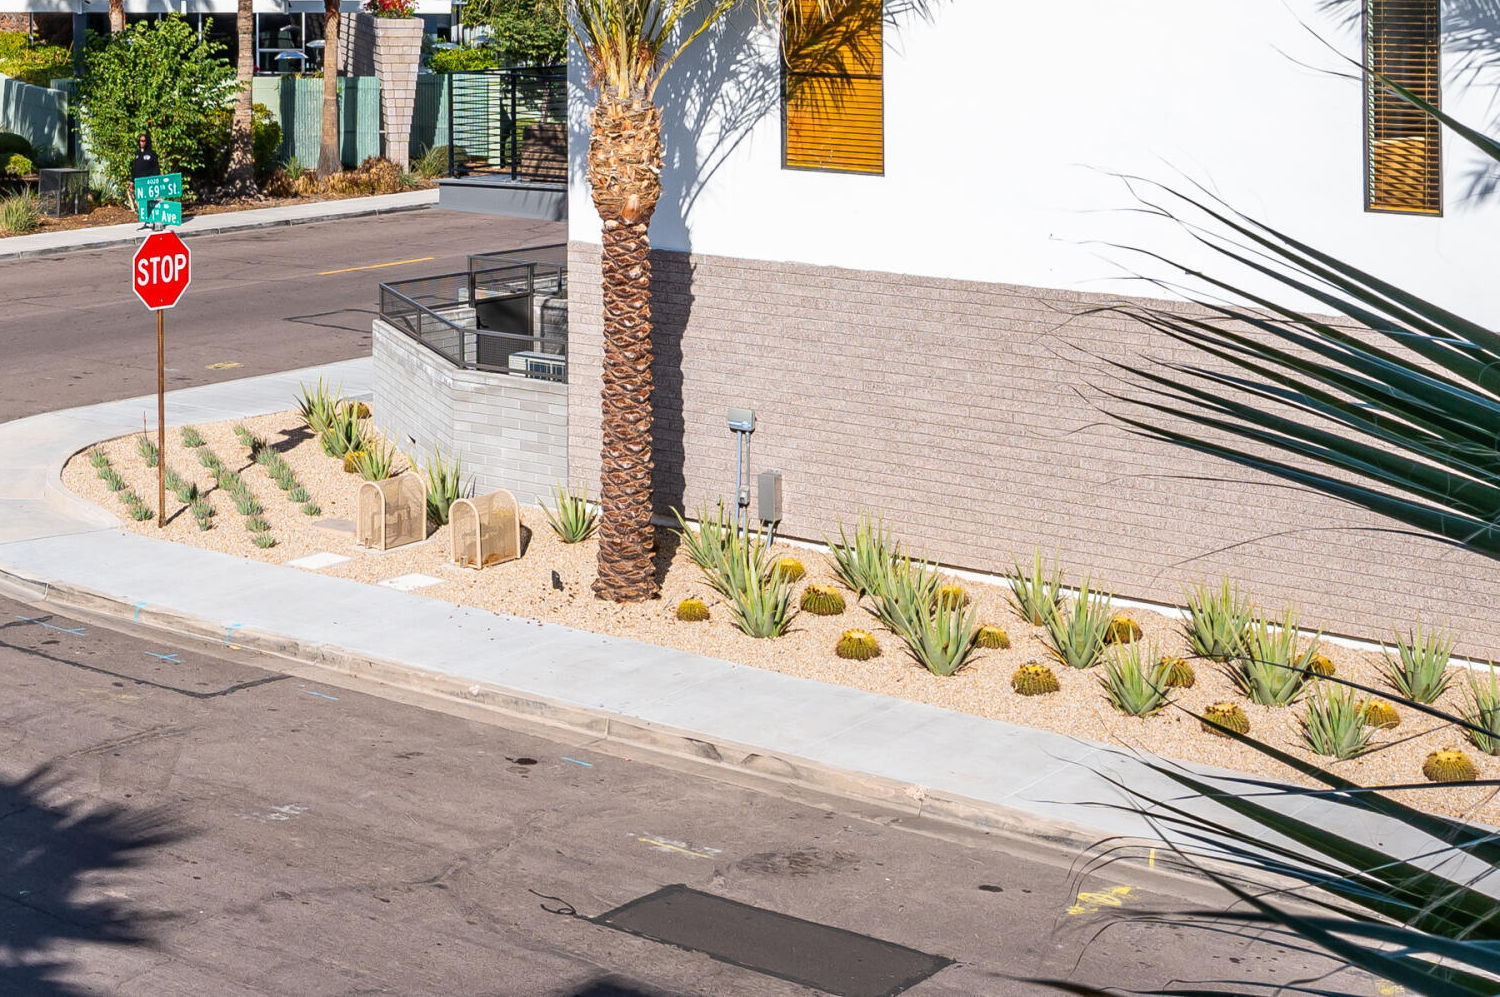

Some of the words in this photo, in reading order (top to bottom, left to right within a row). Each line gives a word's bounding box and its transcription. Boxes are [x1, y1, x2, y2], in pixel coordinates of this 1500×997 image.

[137, 187, 147, 199] N.
[148, 184, 166, 198] 69th
[168, 183, 180, 195] St.
[140, 208, 148, 220] E.
[161, 210, 180, 224] Ave.
[137, 253, 187, 286] STOP
